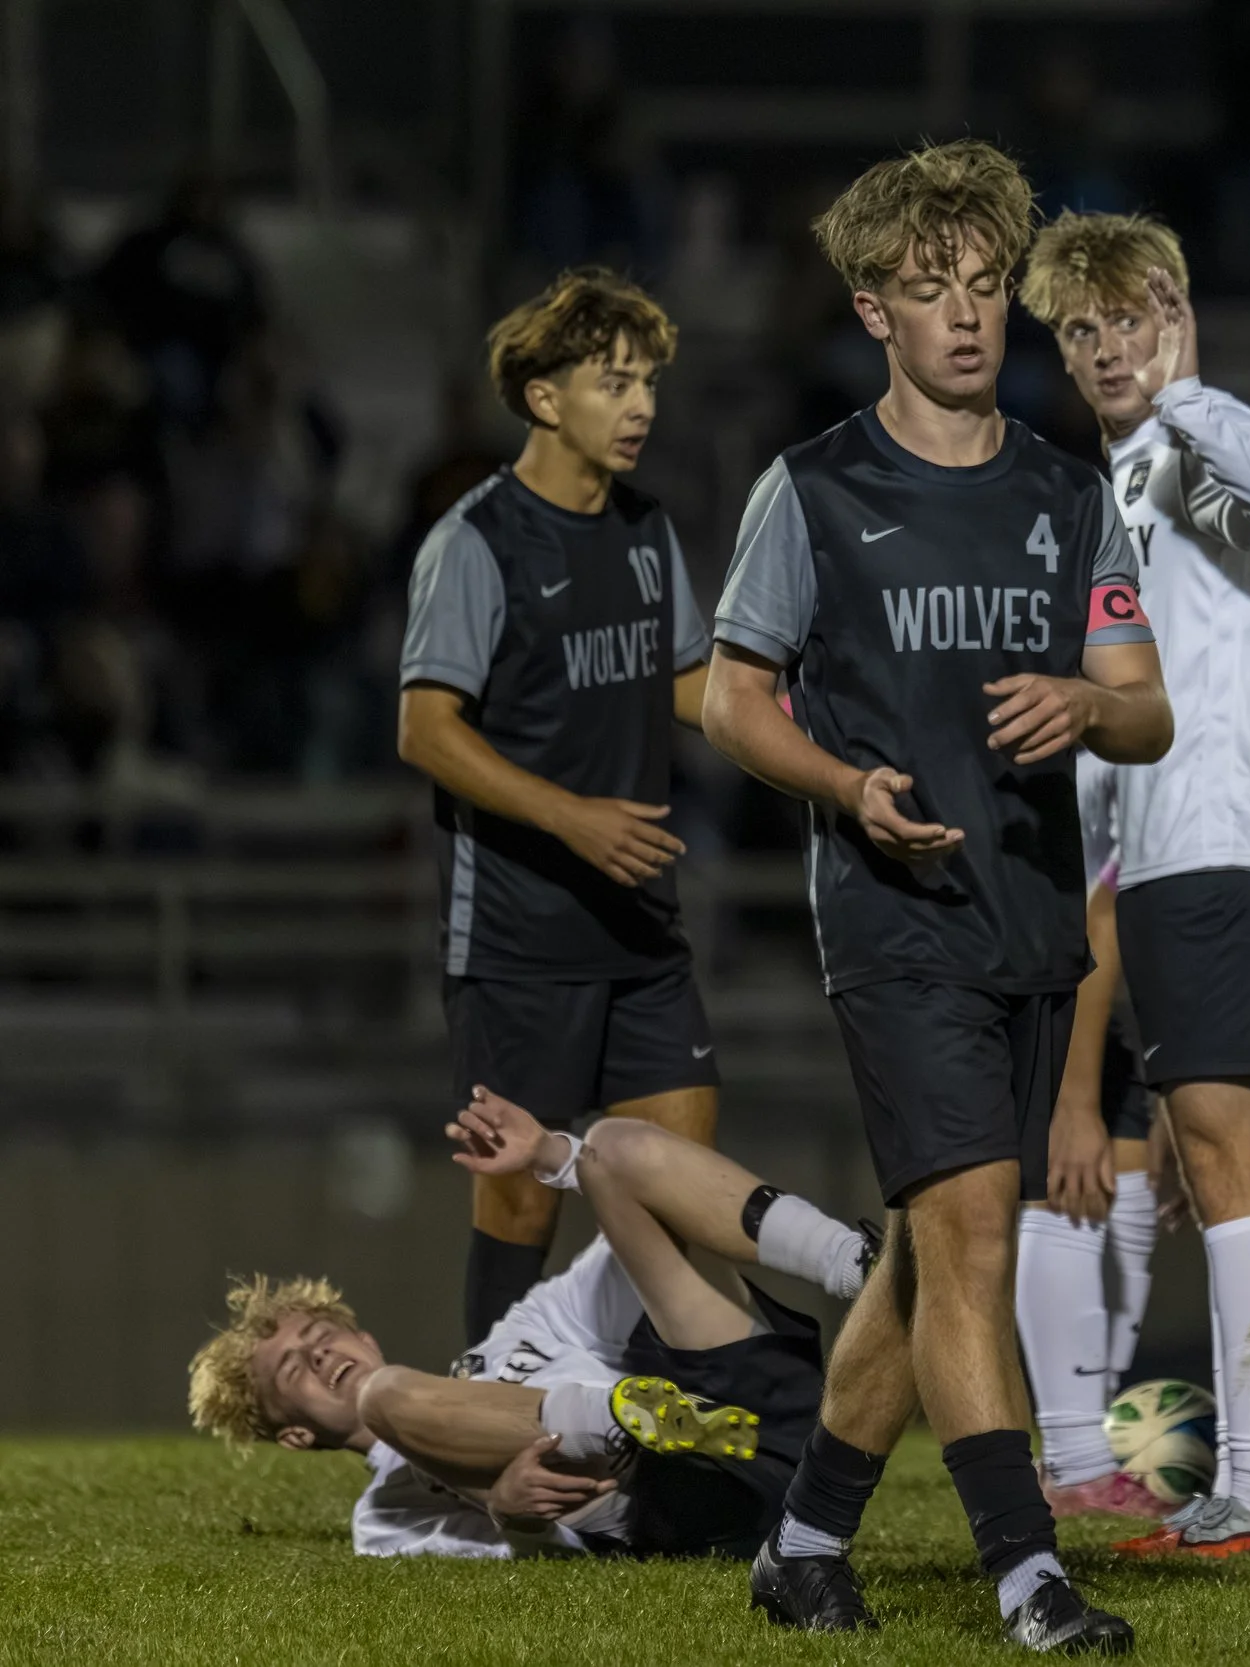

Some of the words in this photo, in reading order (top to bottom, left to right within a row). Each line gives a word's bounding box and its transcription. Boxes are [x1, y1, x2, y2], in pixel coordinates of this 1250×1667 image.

[1026, 513, 1060, 573] 4
[628, 546, 663, 605] 10
[1102, 589, 1136, 620] C
[882, 585, 1051, 653] WOLVES
